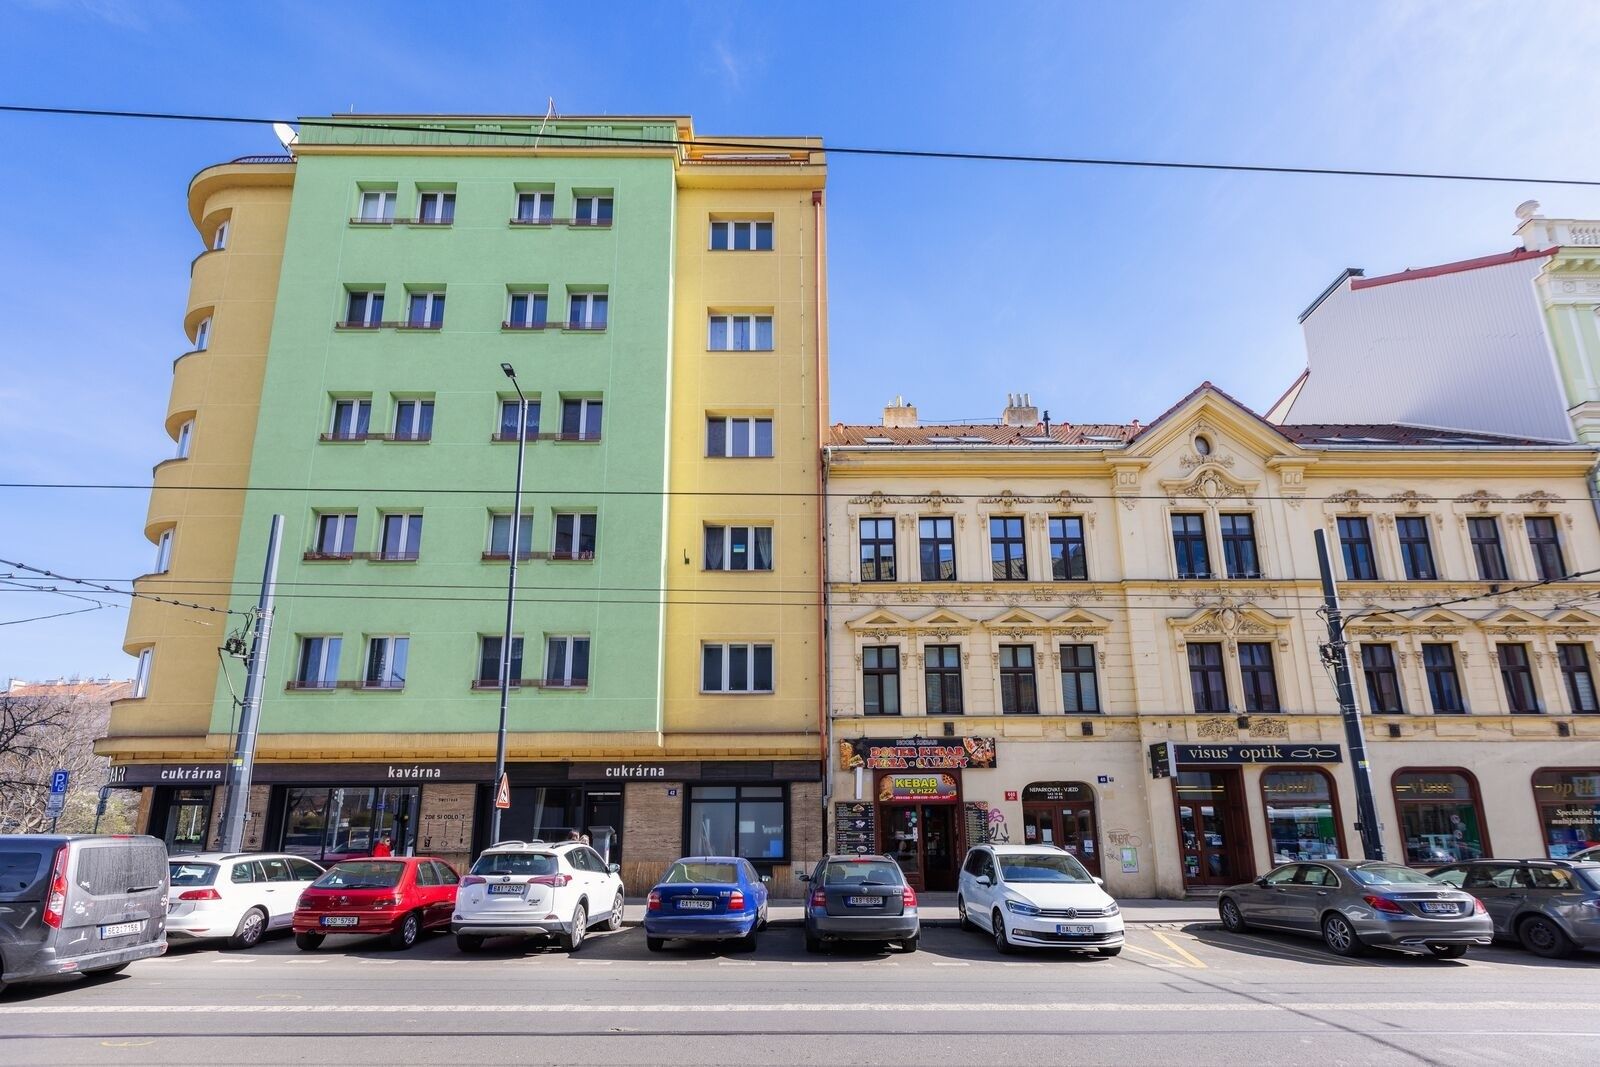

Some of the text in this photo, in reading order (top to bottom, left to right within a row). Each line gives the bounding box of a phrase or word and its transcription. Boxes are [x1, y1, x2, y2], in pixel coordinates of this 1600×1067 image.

[919, 747, 965, 757] KEBAB
[1239, 746, 1283, 762] optik
[161, 768, 222, 780] cukrárna
[388, 766, 441, 778] kavárna
[605, 765, 665, 777] cukrárna
[55, 773, 65, 787] P
[895, 778, 938, 788] KEBAB
[1408, 779, 1454, 794] visus
[1552, 780, 1593, 797] optik
